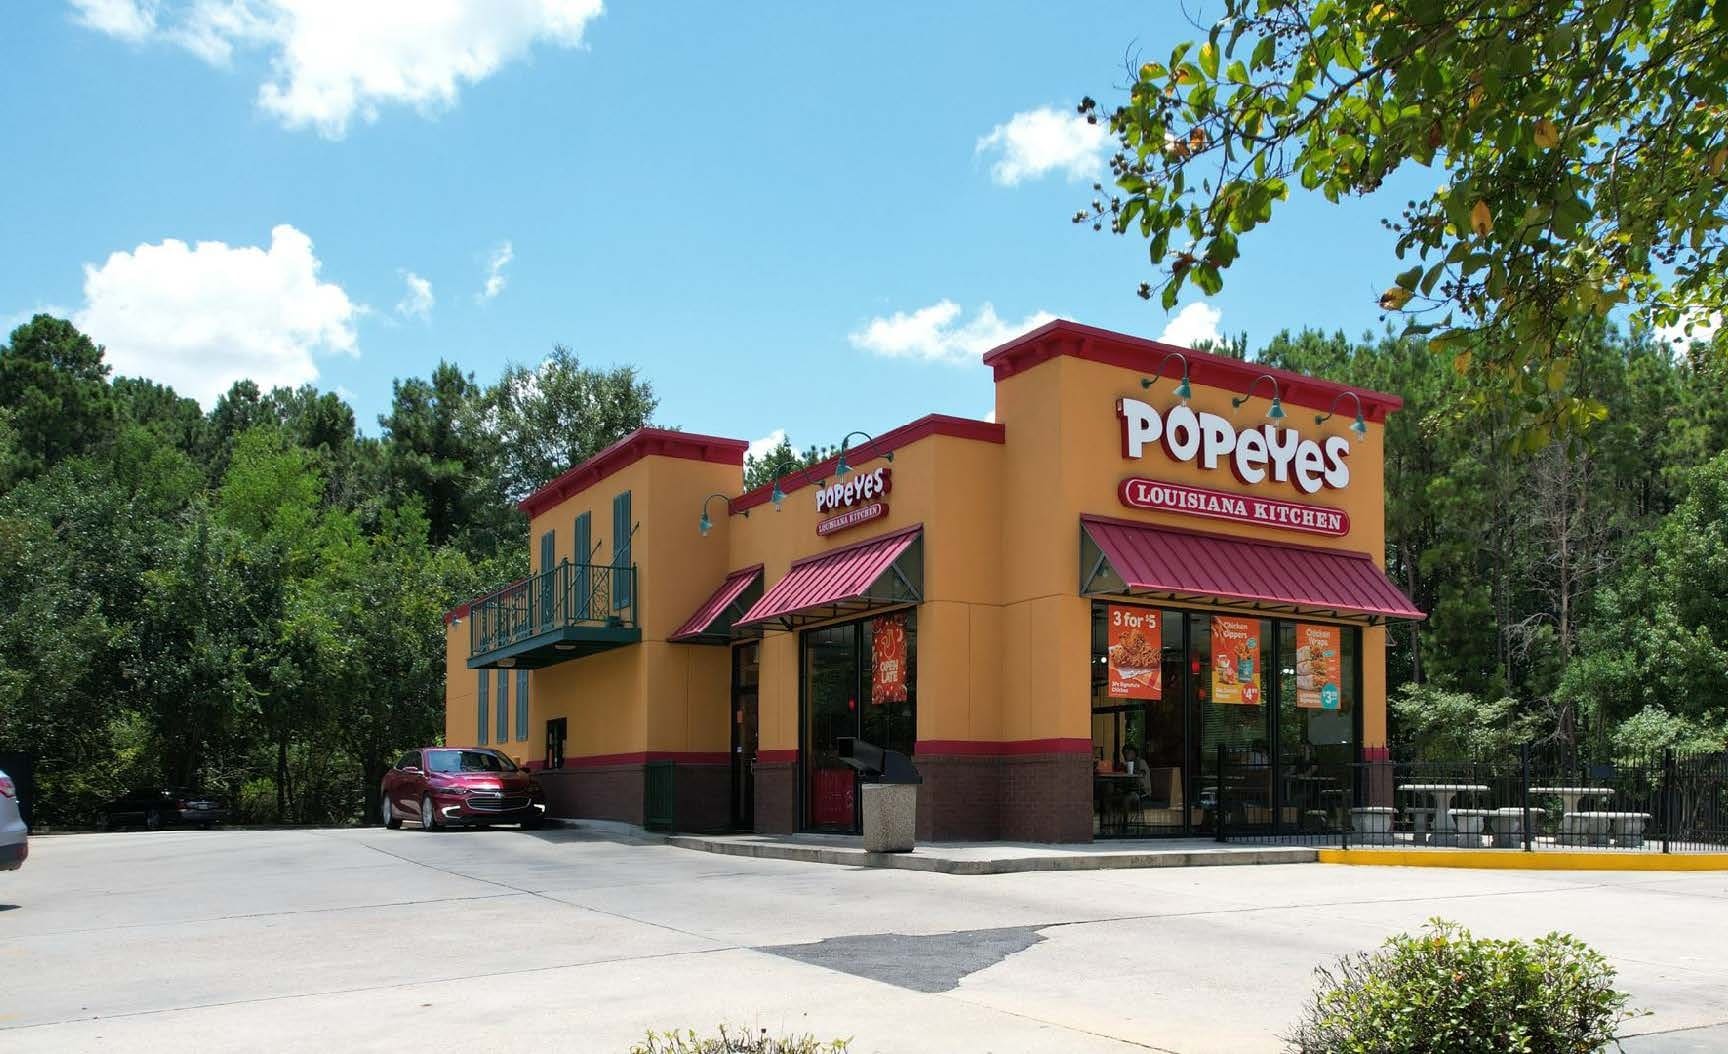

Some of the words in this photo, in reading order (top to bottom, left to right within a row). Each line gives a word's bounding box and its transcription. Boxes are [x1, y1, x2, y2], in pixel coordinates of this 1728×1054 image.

[1137, 484, 1248, 517] LOUISIANA
[1253, 503, 1342, 531] KITCHEN
[818, 516, 849, 533] LOUISIANA
[849, 506, 878, 523] KITCHEN
[1113, 611, 1121, 626] 3
[1123, 612, 1144, 628] for
[880, 659, 899, 673] OPEN
[881, 669, 899, 684] LATE
